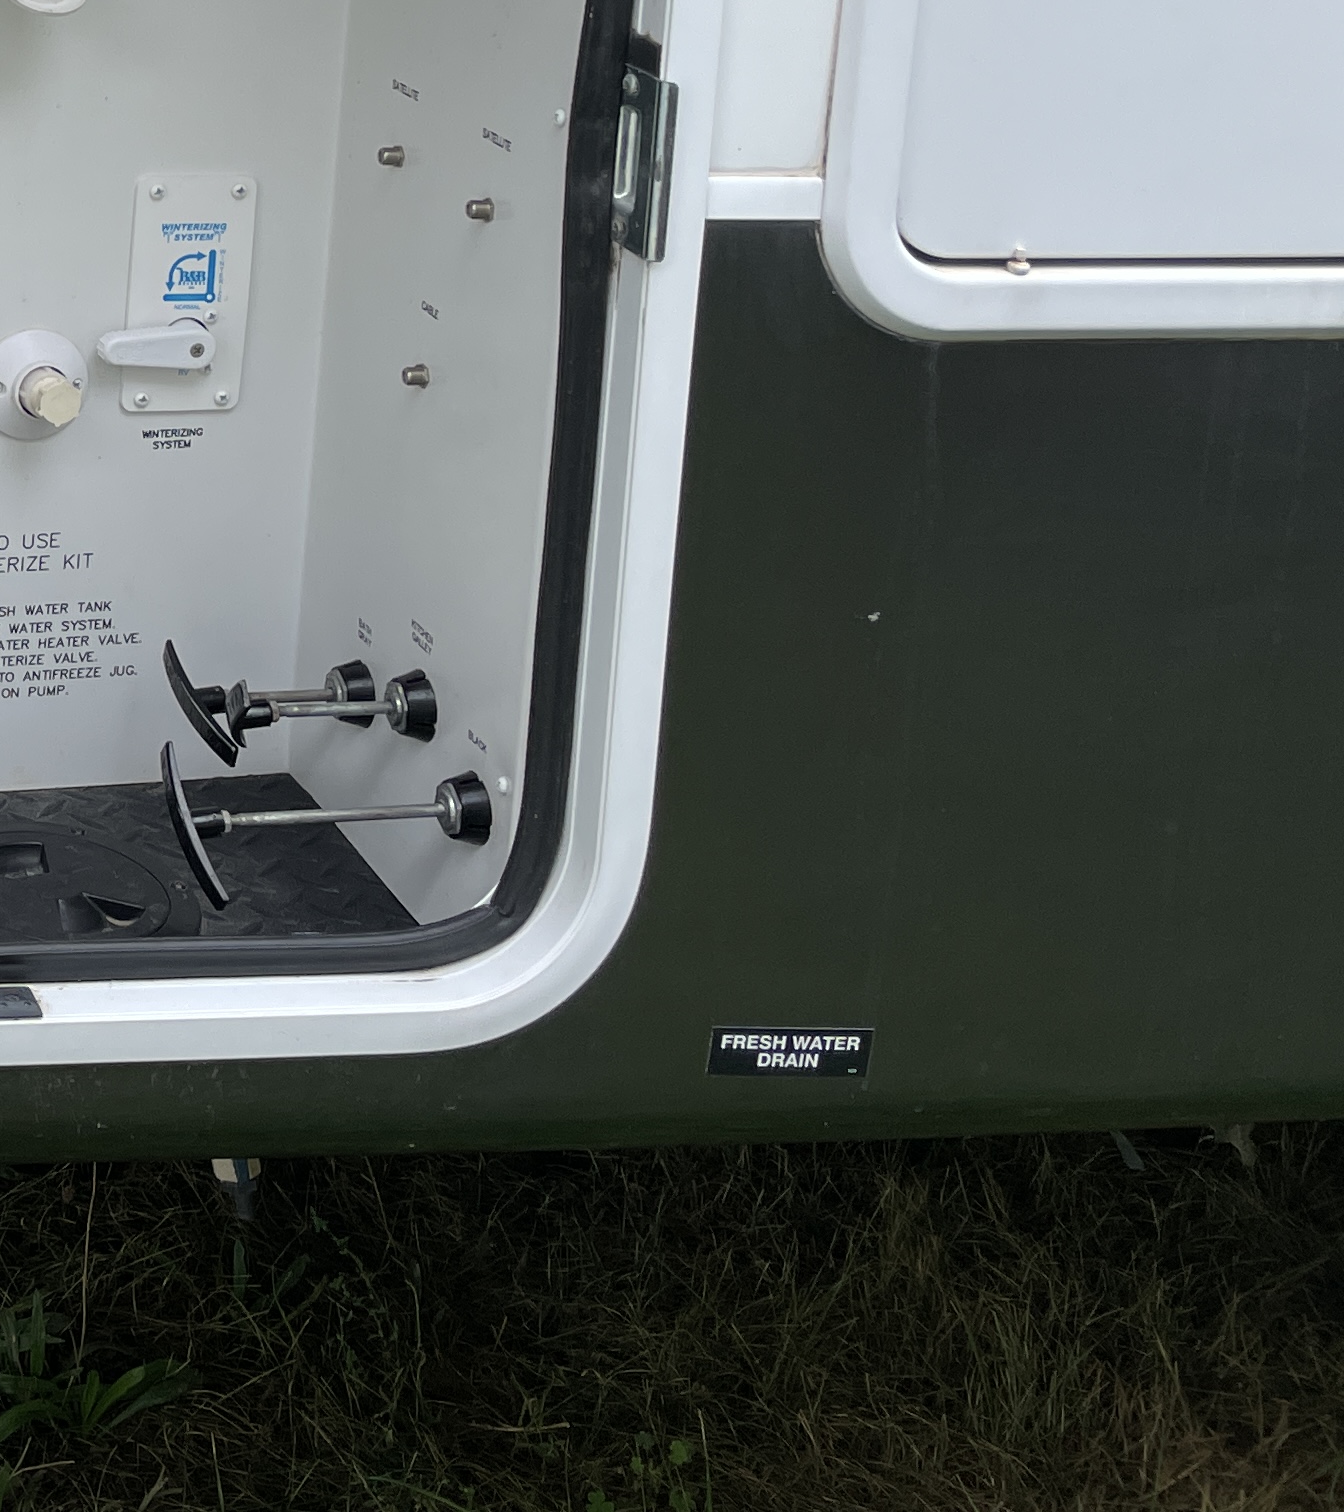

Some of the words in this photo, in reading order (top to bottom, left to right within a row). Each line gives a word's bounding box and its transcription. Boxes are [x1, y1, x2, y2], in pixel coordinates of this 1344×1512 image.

[162, 222, 227, 232] WINTERIZING
[174, 233, 215, 242] SYSTEM
[142, 427, 203, 439] WINTERIZING
[152, 439, 191, 450] SYSTEM
[22, 532, 61, 549] USE
[63, 552, 94, 570] KIT
[24, 603, 69, 616] WATER
[77, 601, 112, 613] TANK
[8, 621, 53, 635] WATER
[61, 618, 116, 632] SYSTEM.
[37, 635, 90, 649] HEATER
[98, 632, 143, 646] VALVE.
[54, 651, 98, 664] VALVE.
[22, 666, 102, 682] ANTIFREEZE
[109, 665, 138, 678] JUG.
[1, 687, 19, 699] ON
[28, 684, 69, 698] PUMP.
[720, 1034, 787, 1050] FRESH
[792, 1034, 861, 1051] WATER
[756, 1052, 820, 1068] DRAIN
